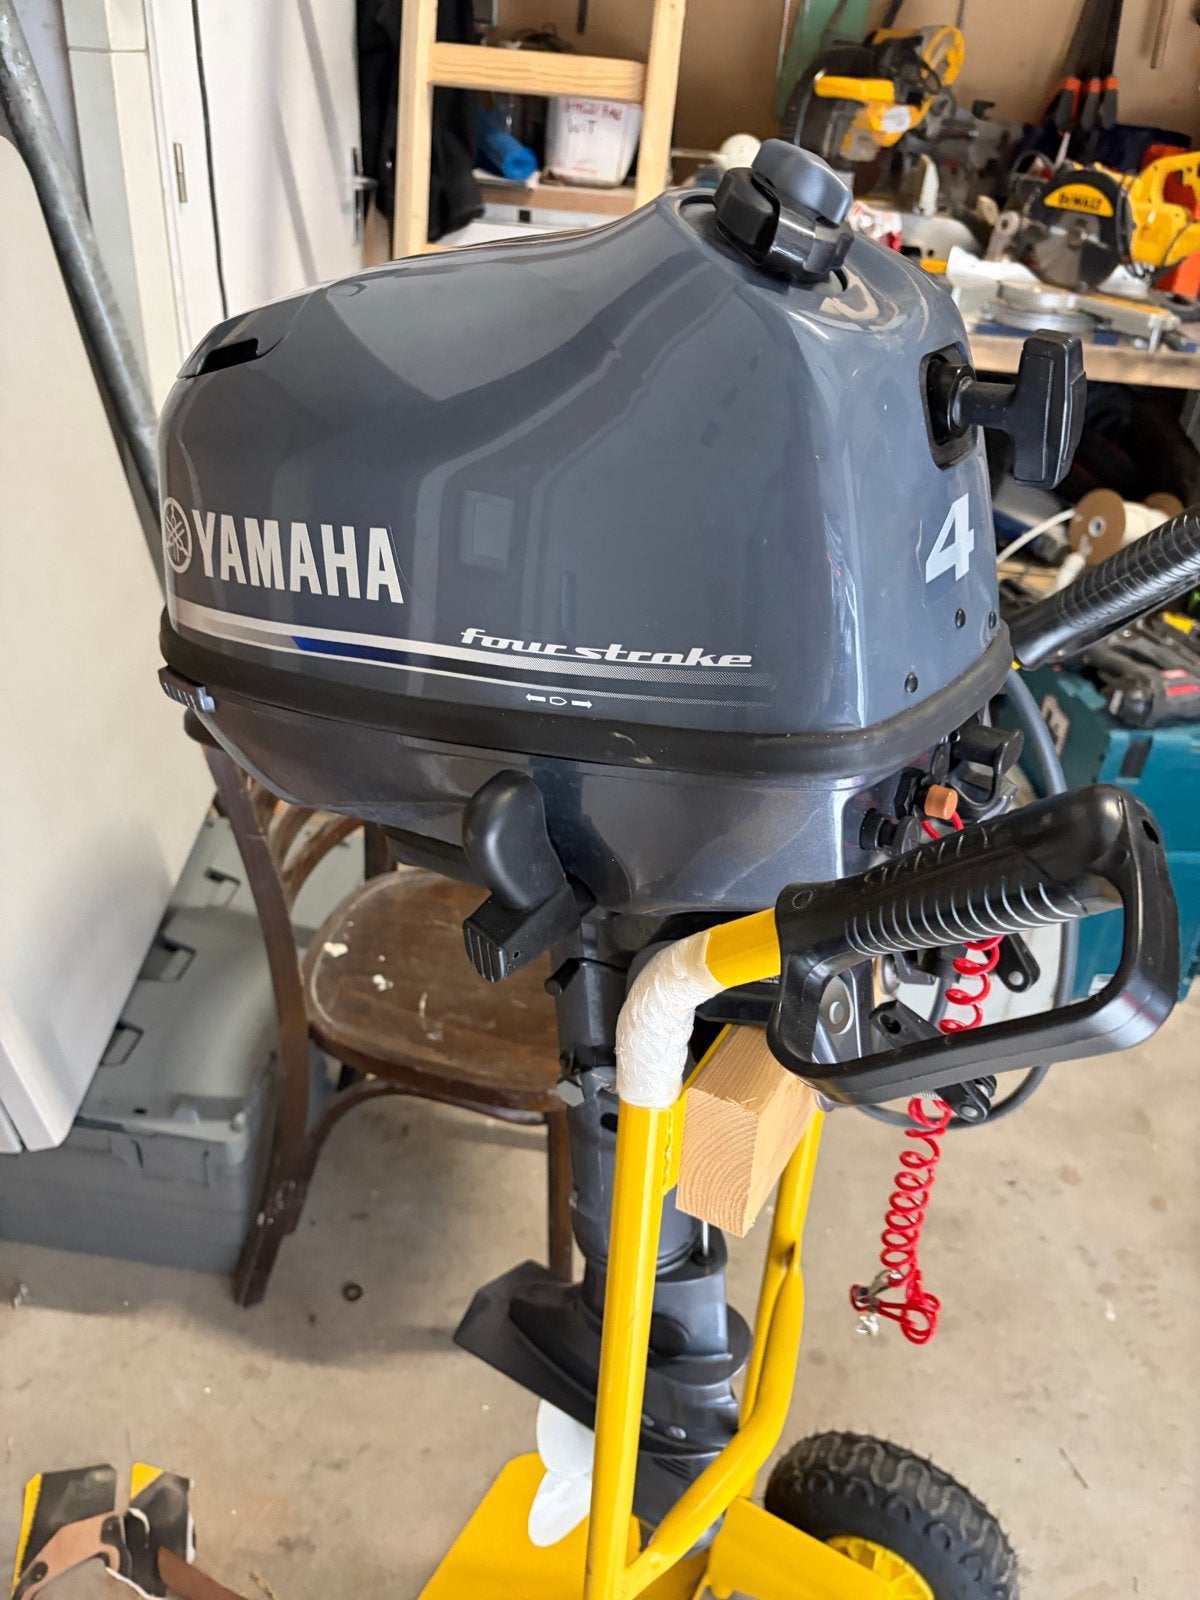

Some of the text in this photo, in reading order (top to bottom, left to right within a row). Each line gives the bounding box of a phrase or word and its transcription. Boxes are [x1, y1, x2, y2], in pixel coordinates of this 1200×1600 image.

[191, 509, 404, 604] YAMAHA
[926, 493, 974, 584] 4
[461, 628, 752, 667] four stroke
